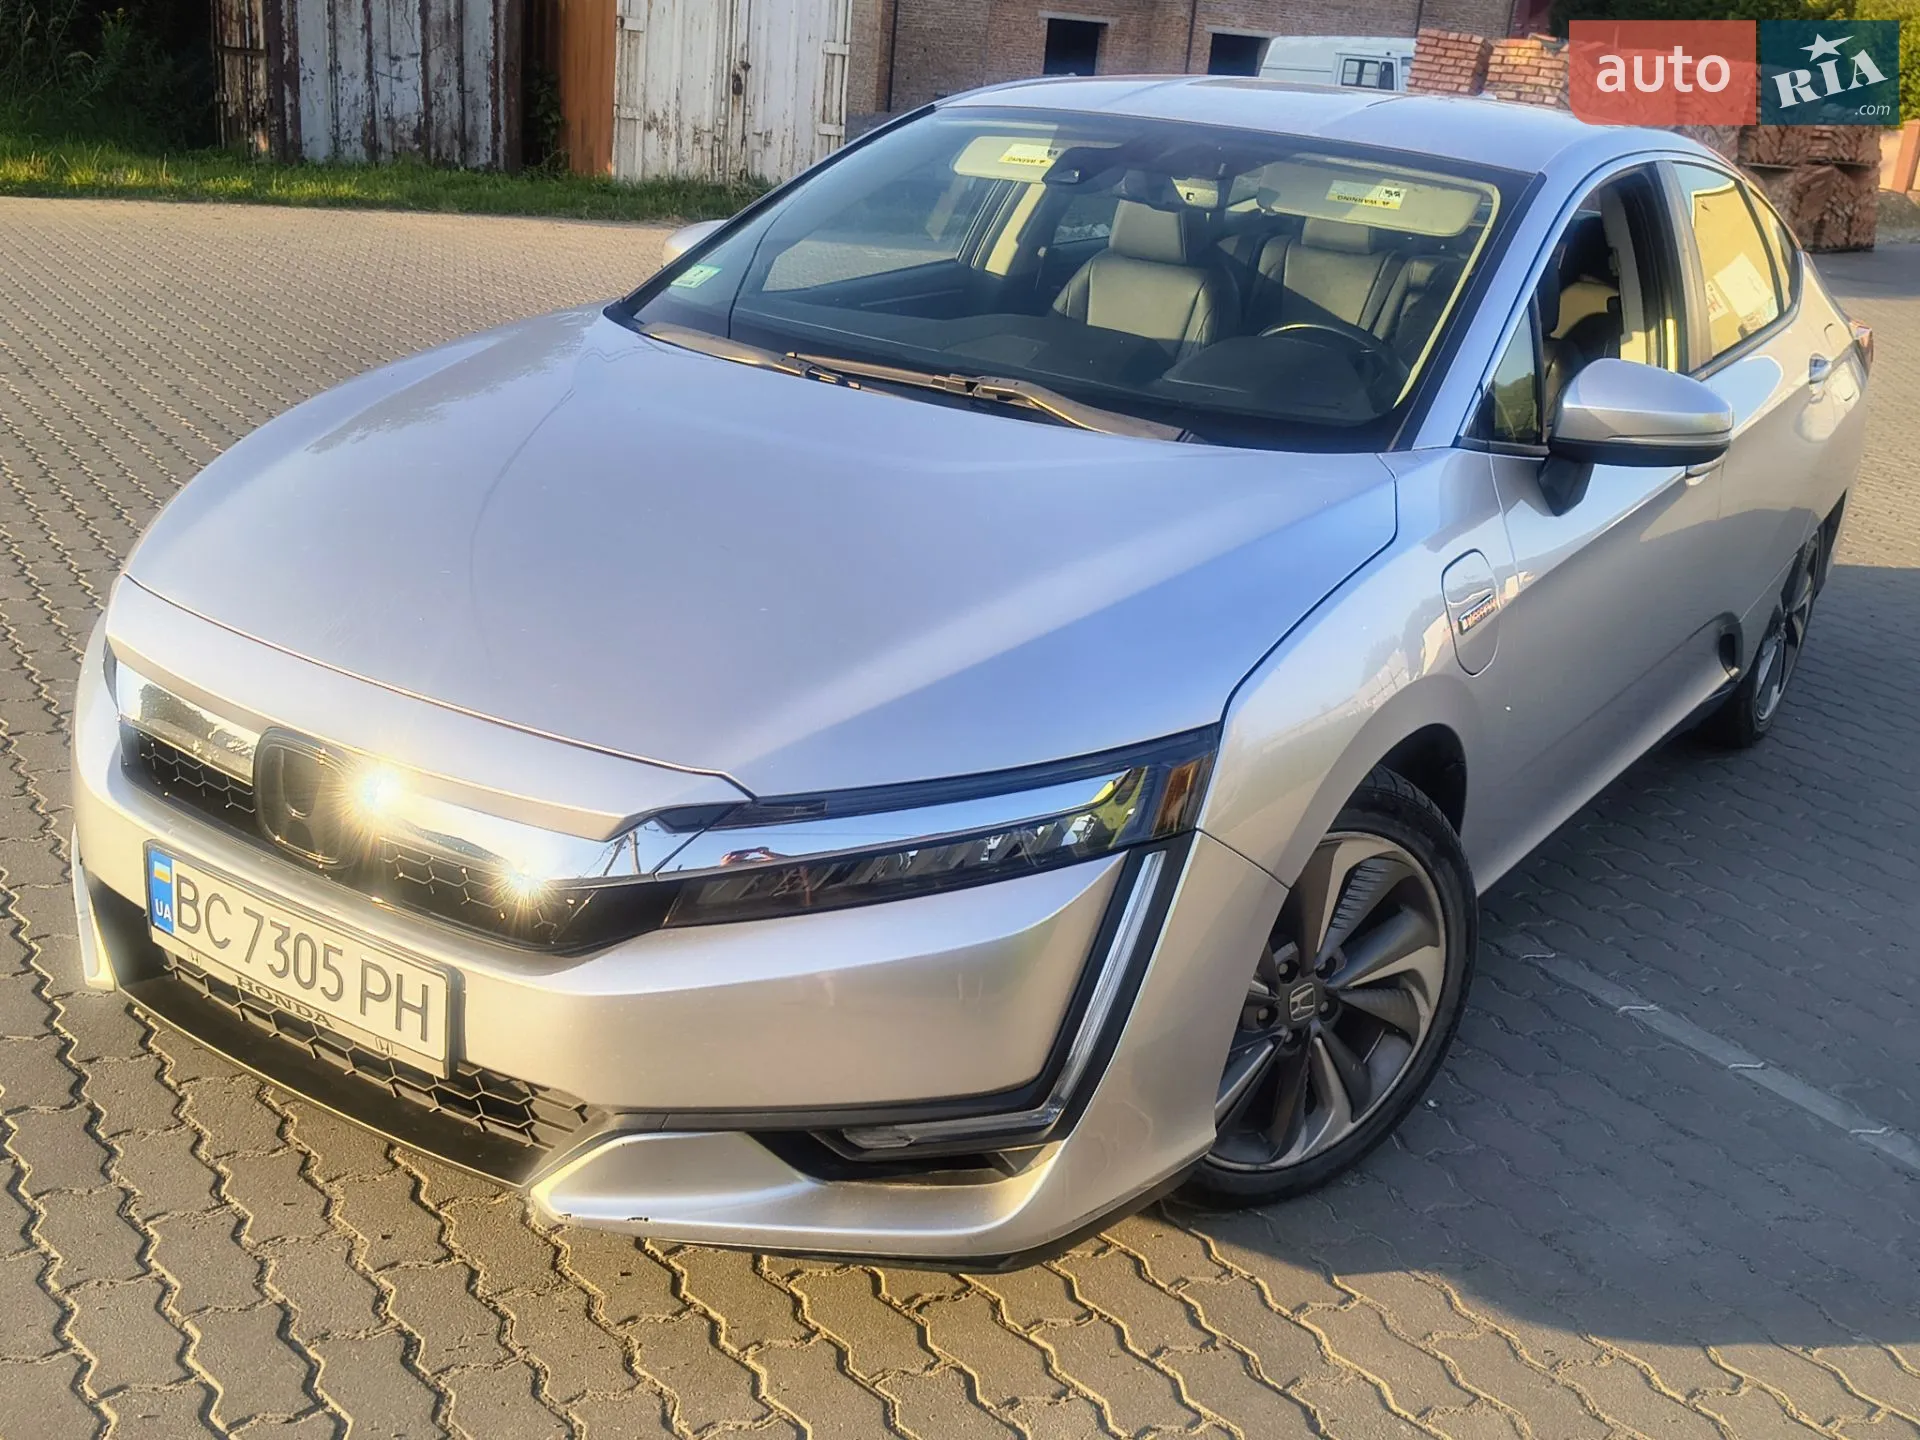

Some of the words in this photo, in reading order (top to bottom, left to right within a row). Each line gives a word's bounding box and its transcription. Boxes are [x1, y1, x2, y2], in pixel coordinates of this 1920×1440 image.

[1336, 194, 1377, 205] WARNING
[155, 898, 173, 921] UA
[176, 873, 232, 949] BC
[243, 906, 344, 1002] 7305
[361, 958, 428, 1042] PH
[236, 975, 335, 1030] HONDA
